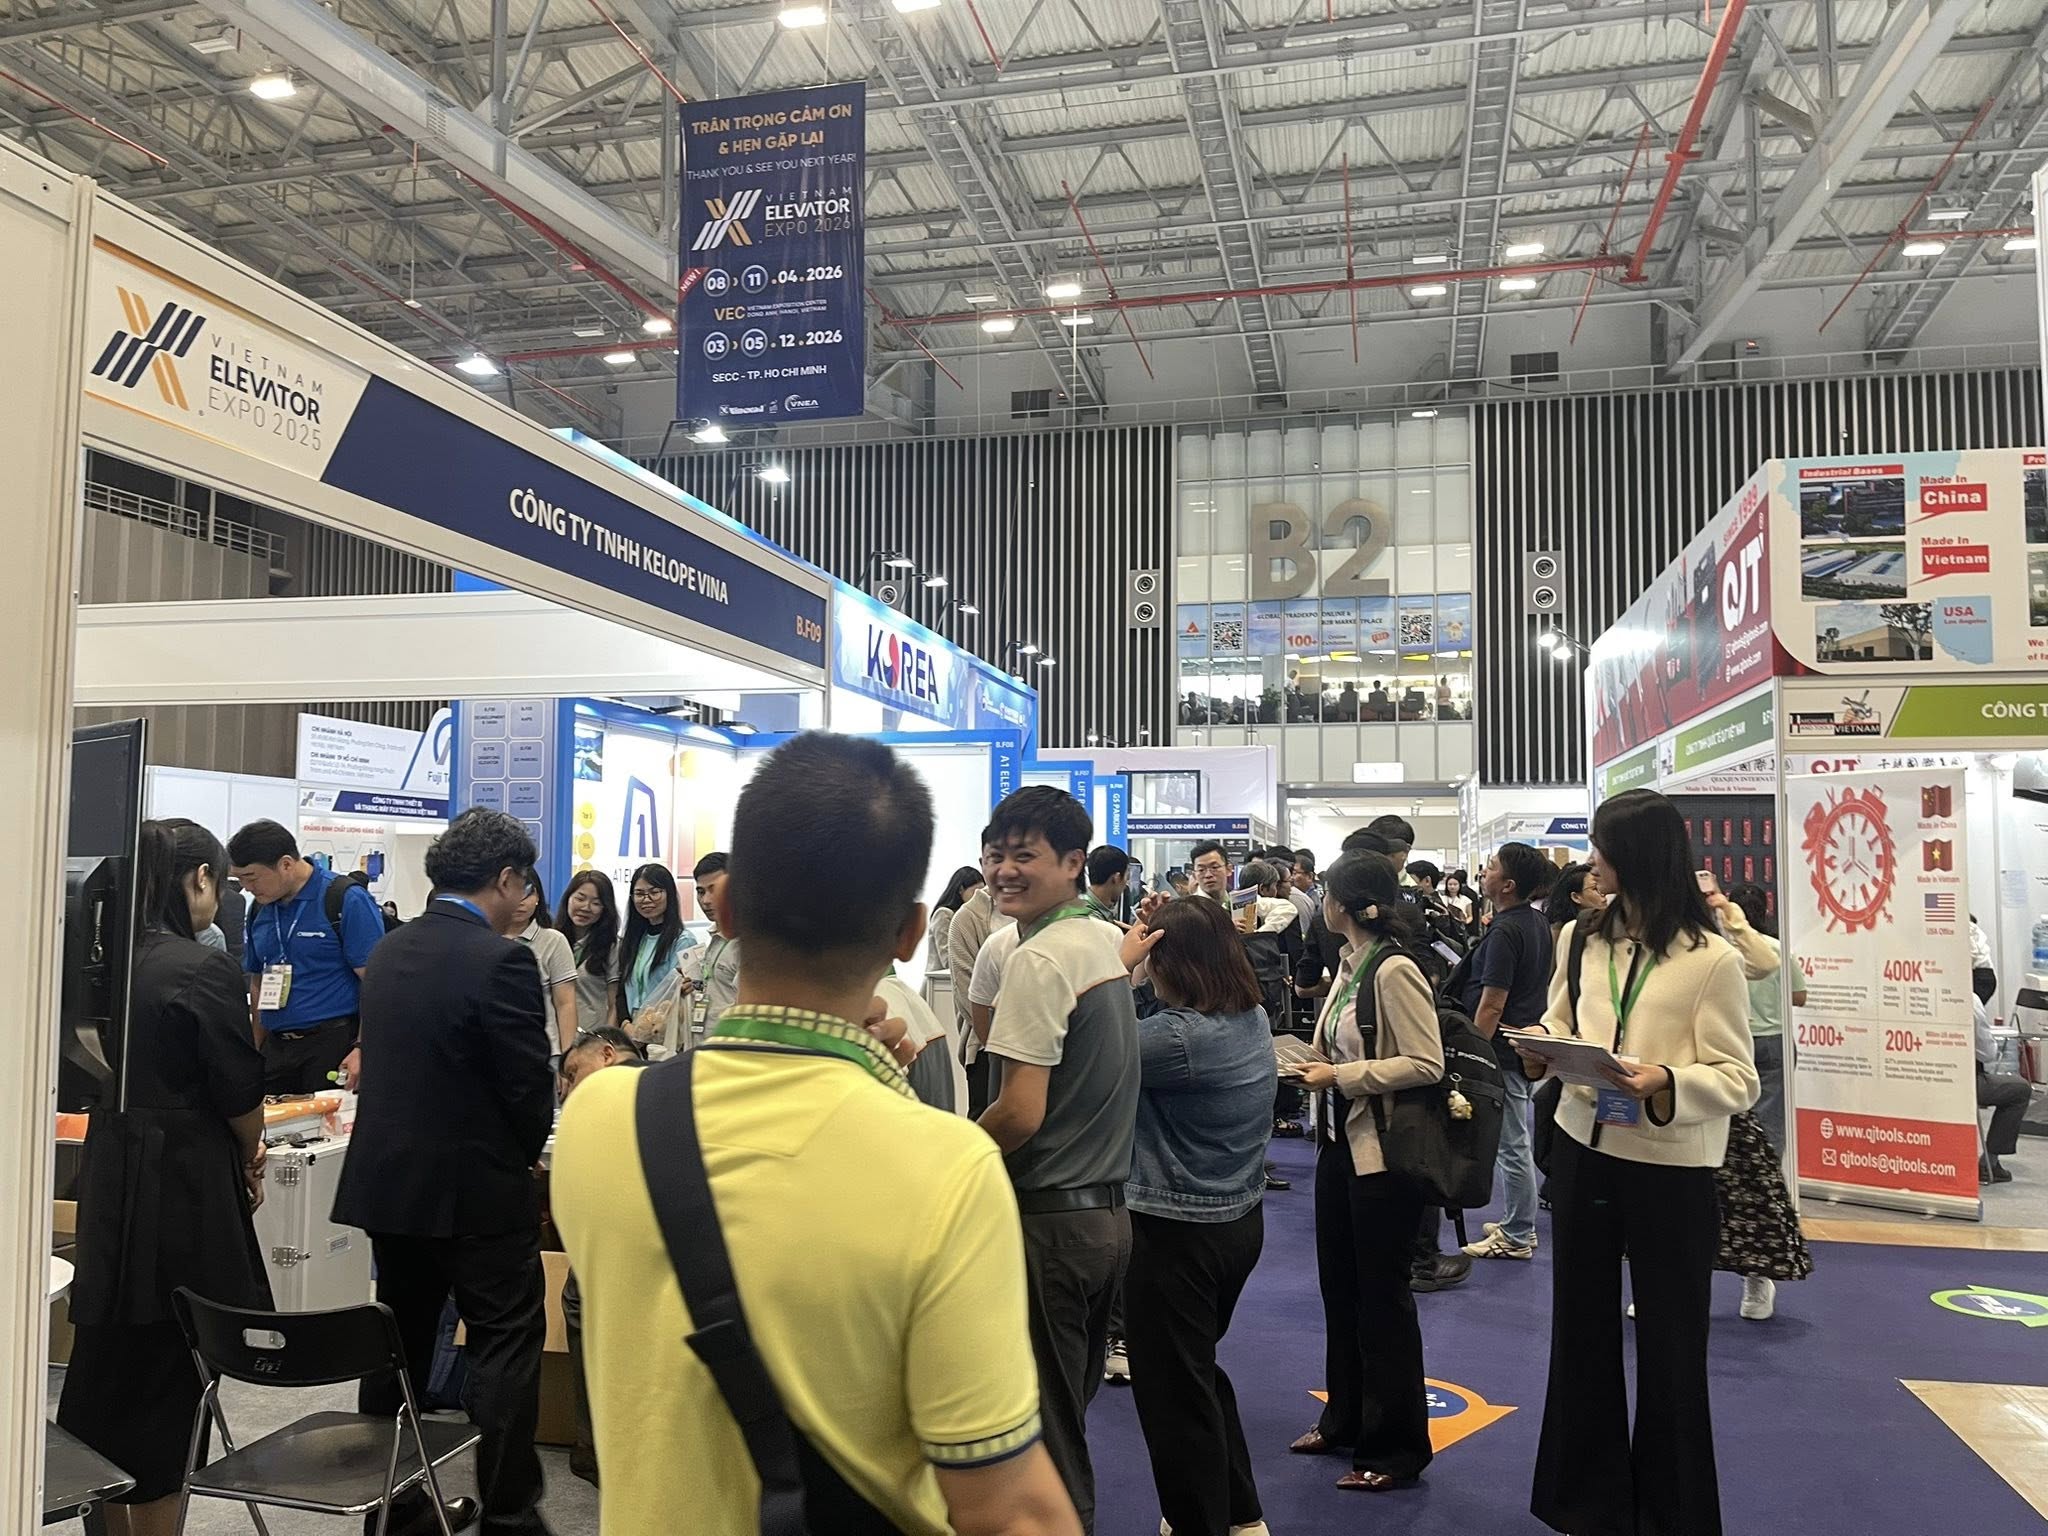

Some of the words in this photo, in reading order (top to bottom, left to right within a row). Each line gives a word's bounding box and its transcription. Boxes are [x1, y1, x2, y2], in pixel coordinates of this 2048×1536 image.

[692, 117, 730, 135] TRÂN
[733, 112, 787, 131] TRỌNG
[790, 105, 825, 124] CẢM
[829, 104, 852, 119] ƠN
[718, 141, 729, 154] &
[732, 137, 762, 155] HẸN
[765, 132, 798, 151] GẶP
[801, 130, 824, 147] LẠI
[687, 167, 719, 180] THANK
[721, 166, 744, 176] YOU
[746, 164, 753, 173] &
[755, 161, 773, 173] SEE
[775, 159, 799, 170] YOU
[801, 156, 826, 167] NEXT
[827, 153, 856, 164] YEAR!
[765, 186, 852, 202] VIETNAM
[765, 198, 851, 221] ELEVATOR
[765, 220, 808, 238] EXPO
[814, 213, 851, 233] 2026
[707, 277, 726, 290] 08
[748, 272, 761, 287] 11
[714, 306, 746, 321] VEC
[707, 340, 725, 354] 03
[745, 336, 764, 350] 05
[211, 334, 323, 395] VIETNAM
[712, 372, 739, 383] SECC
[747, 370, 763, 380] TP.
[764, 369, 779, 378] HO
[781, 367, 799, 377] CHI
[800, 365, 827, 376] MINH
[211, 354, 321, 425] ELEVATOR
[208, 386, 266, 428] EXPO
[273, 413, 321, 451] 2025
[1803, 469, 1851, 478] Industrial
[1853, 467, 1883, 475] Bases
[1919, 475, 1951, 484] Made
[1956, 474, 1967, 483] In
[1923, 490, 1982, 506] China
[1251, 498, 1390, 600] B2
[1921, 537, 1951, 546] Made
[1958, 536, 1970, 545] In
[509, 488, 566, 536] CÔNG
[569, 513, 593, 546] TY
[594, 524, 640, 568] TNHH
[643, 546, 697, 592] KELOPE
[698, 570, 729, 605] VINA
[796, 615, 822, 643] B.F09
[1924, 553, 1988, 565] Vietnam
[1944, 606, 1974, 617] USA
[1287, 635, 1318, 647] 100+
[867, 624, 939, 704] KOREA
[1981, 700, 2037, 718] CÔNG
[1834, 724, 1880, 733] VIETNAM
[1561, 822, 1579, 830] CÔNG
[1884, 960, 1923, 982] 400K
[1798, 1024, 1844, 1047] 2,000+
[1886, 1029, 1923, 1052] 200+
[1837, 1124, 1931, 1146] www.qjtools.com
[1840, 1154, 1956, 1177] qjtools@qjtools.com
